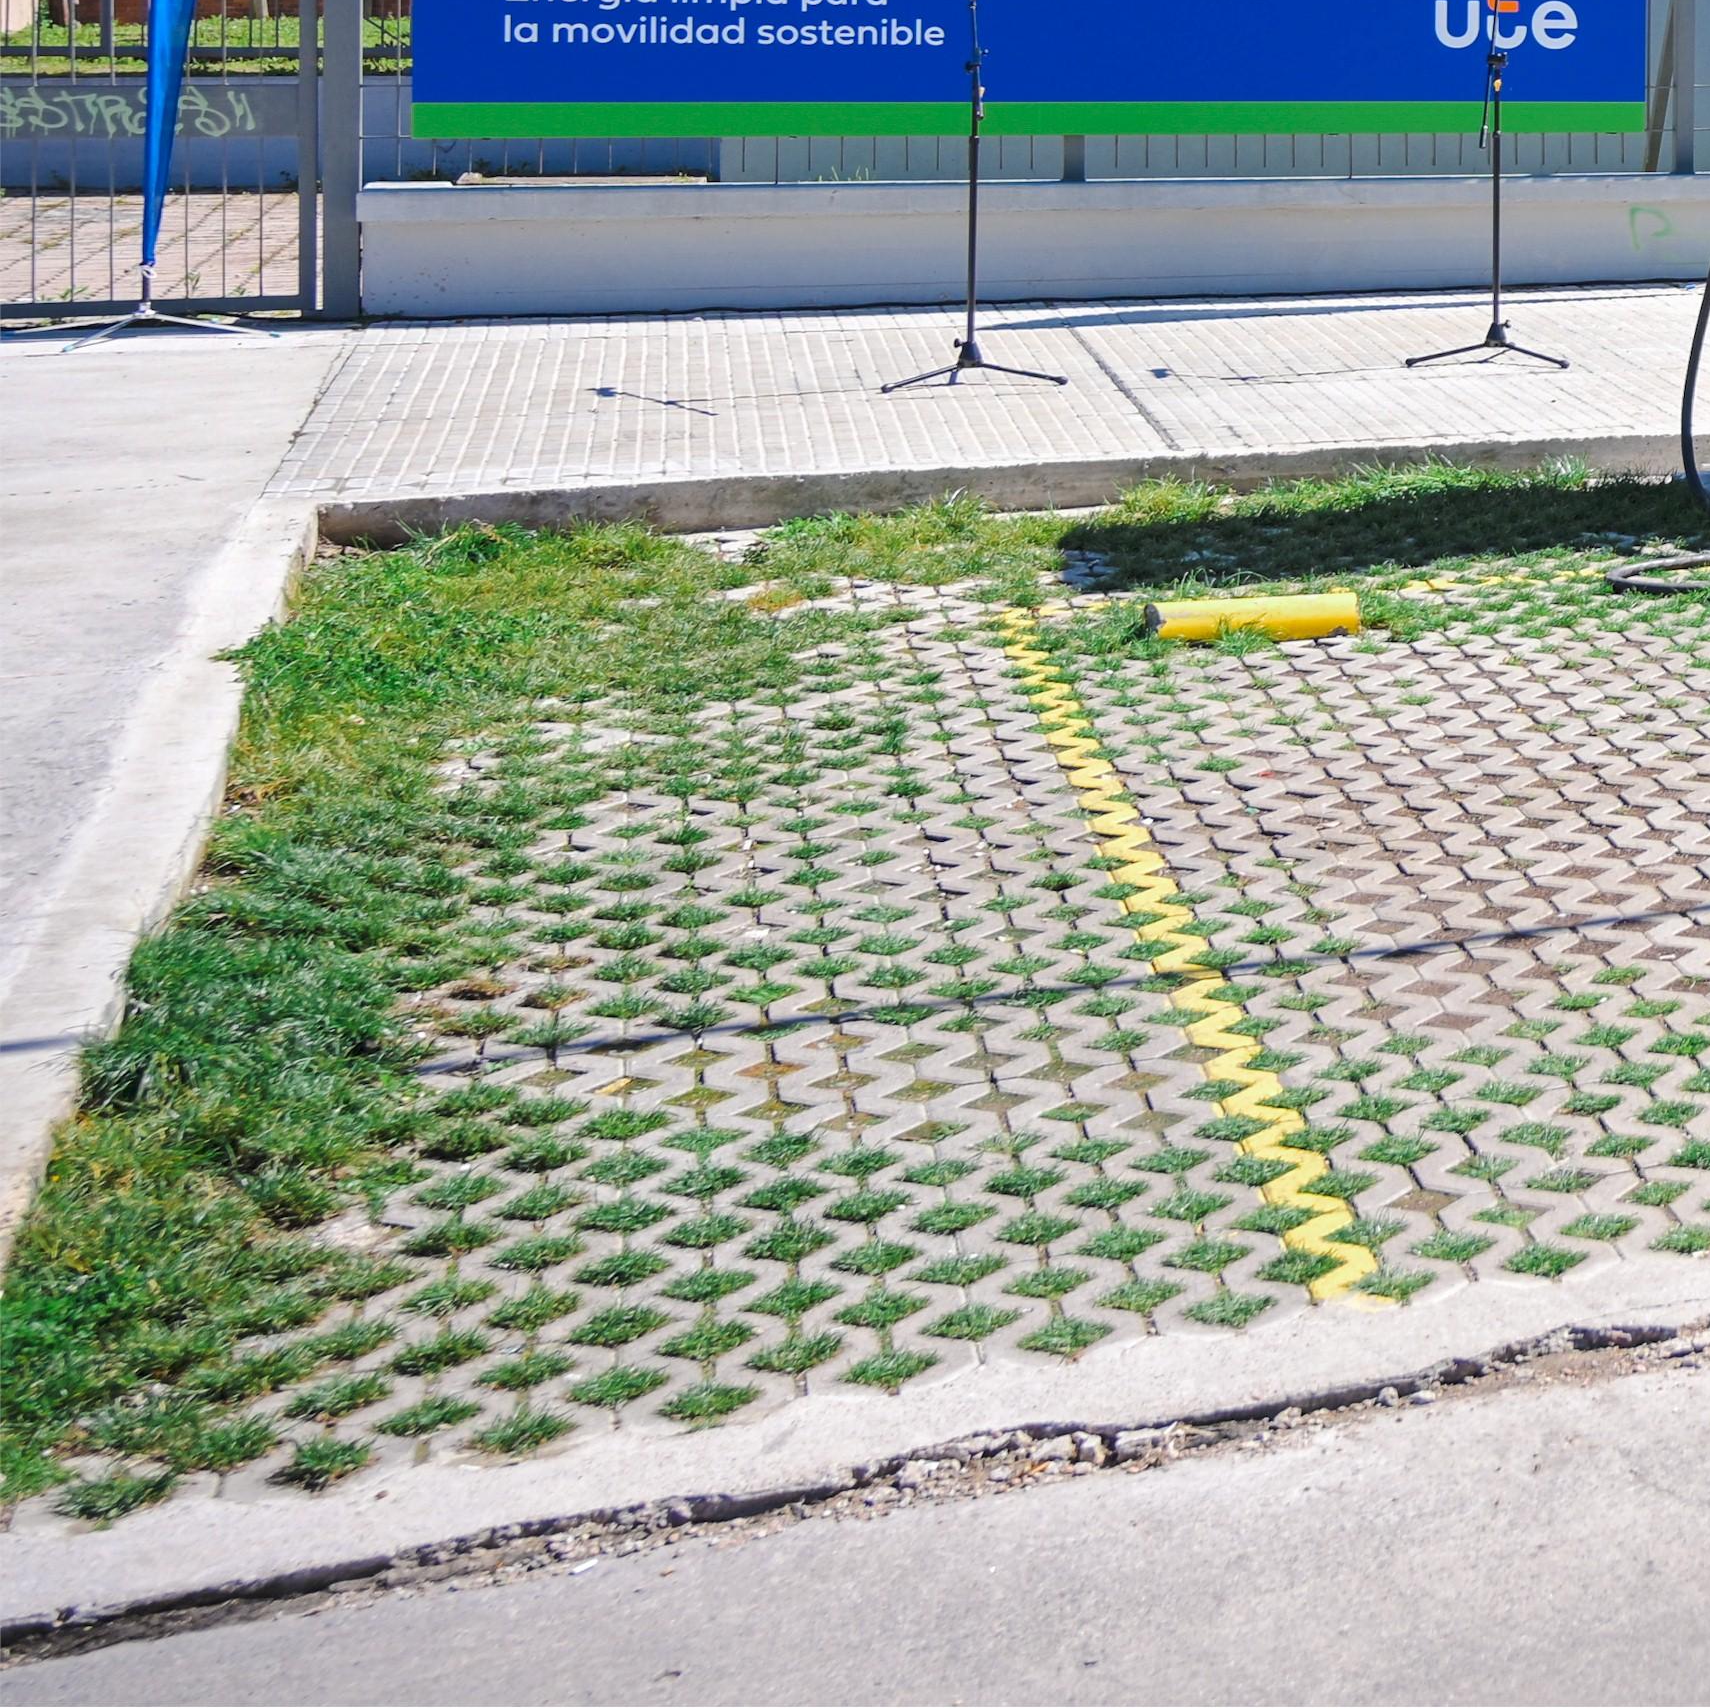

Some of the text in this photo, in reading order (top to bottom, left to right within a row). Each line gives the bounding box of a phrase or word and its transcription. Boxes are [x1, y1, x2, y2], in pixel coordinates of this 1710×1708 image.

[504, 14, 945, 46] la movilidad sostenible
